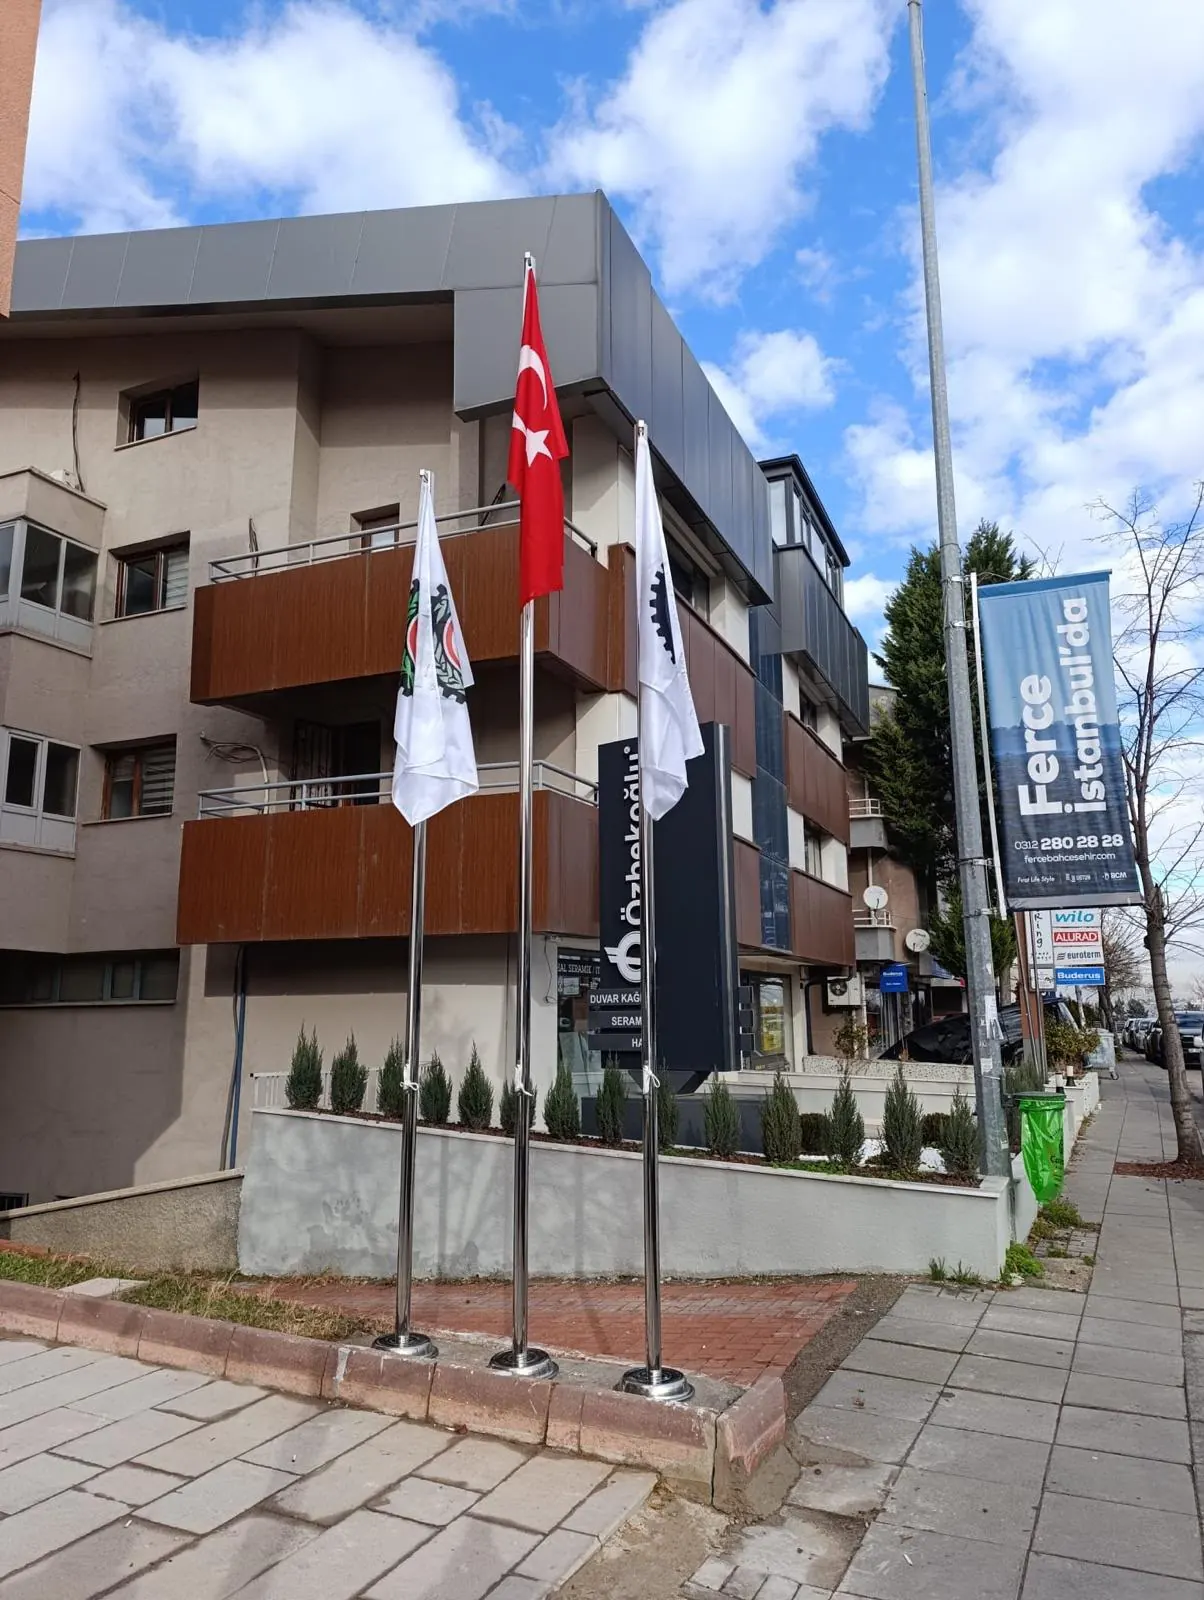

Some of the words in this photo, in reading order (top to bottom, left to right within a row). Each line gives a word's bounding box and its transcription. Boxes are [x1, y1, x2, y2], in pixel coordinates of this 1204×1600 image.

[1018, 674, 1063, 816] Ferce
[1014, 840, 1039, 850] 0312
[1041, 837, 1074, 851] 280
[1076, 835, 1099, 849] 28
[1101, 834, 1124, 848] 28
[1024, 852, 1116, 864] fercebahcesehir.com
[1055, 910, 1095, 923] wilo
[1055, 932, 1098, 942] ALURAD
[1067, 950, 1102, 960] euroterm
[1057, 971, 1101, 980] Buderus
[590, 993, 619, 1004] DUVAR
[621, 991, 641, 1003] KAĞ
[611, 1016, 642, 1026] SERAM
[631, 1038, 642, 1048] HA
